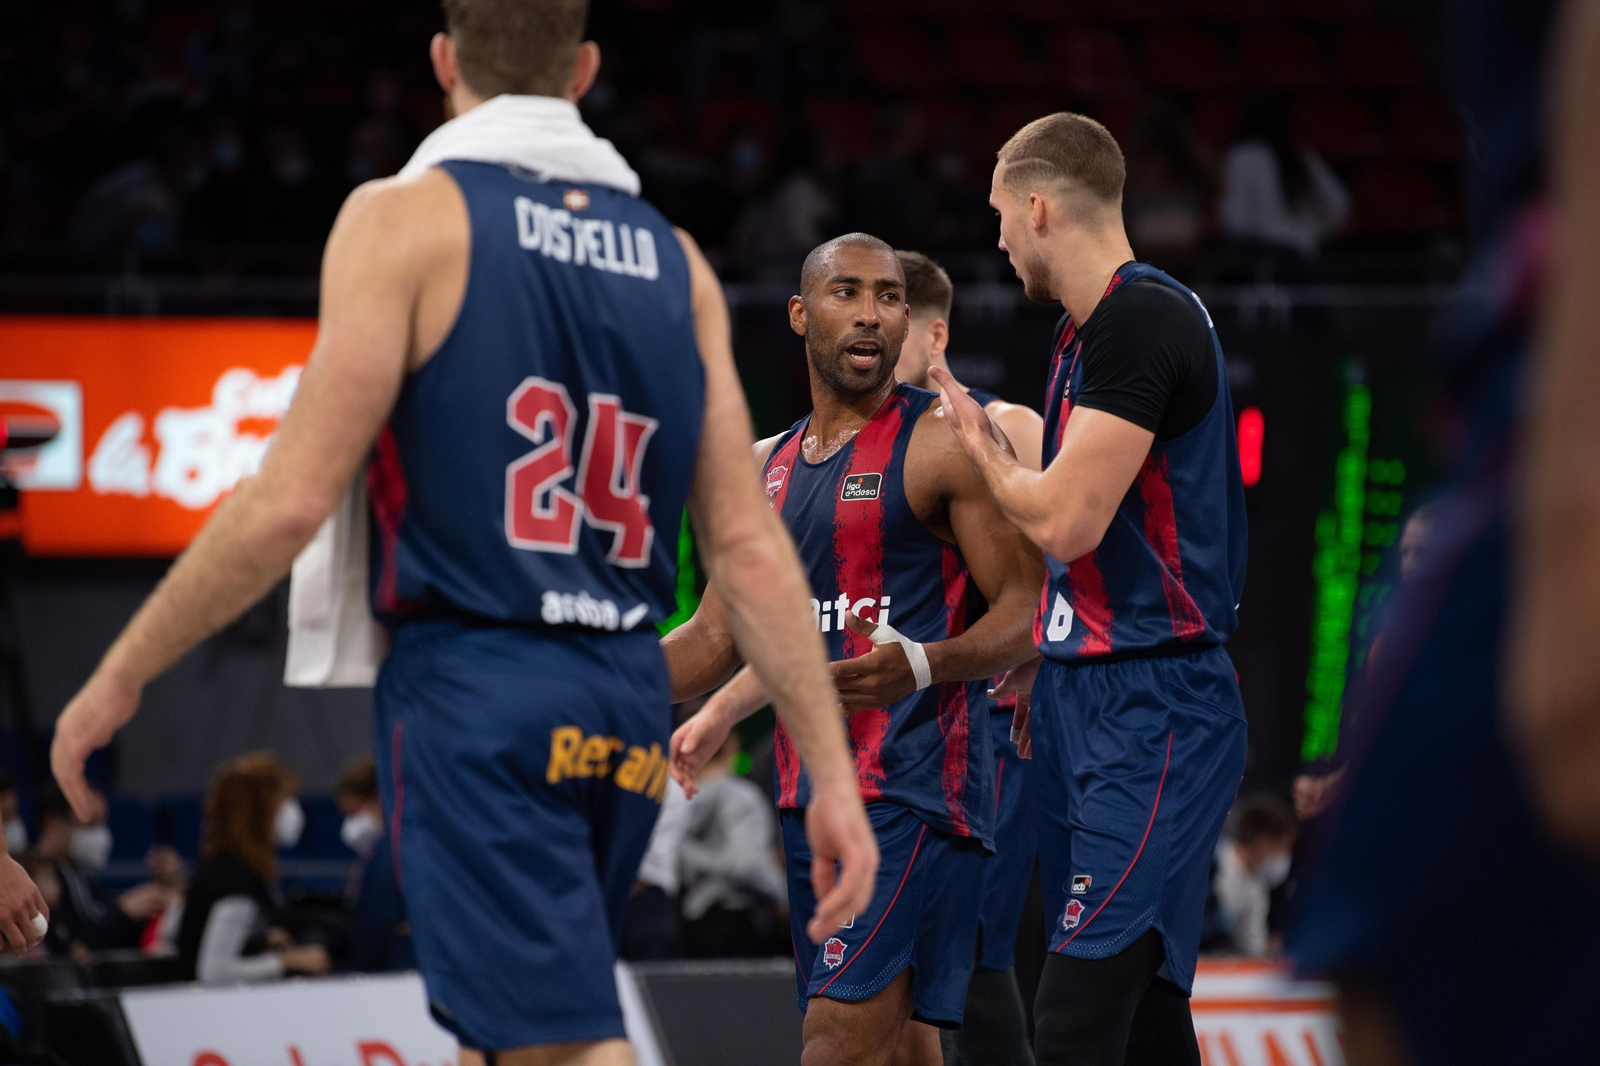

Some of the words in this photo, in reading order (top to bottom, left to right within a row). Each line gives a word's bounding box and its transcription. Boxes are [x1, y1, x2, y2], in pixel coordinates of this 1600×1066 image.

[514, 196, 659, 281] COSTELLO
[504, 376, 658, 568] 24
[846, 483, 861, 491] liga
[845, 489, 876, 497] endesa
[1073, 882, 1086, 891] acb
